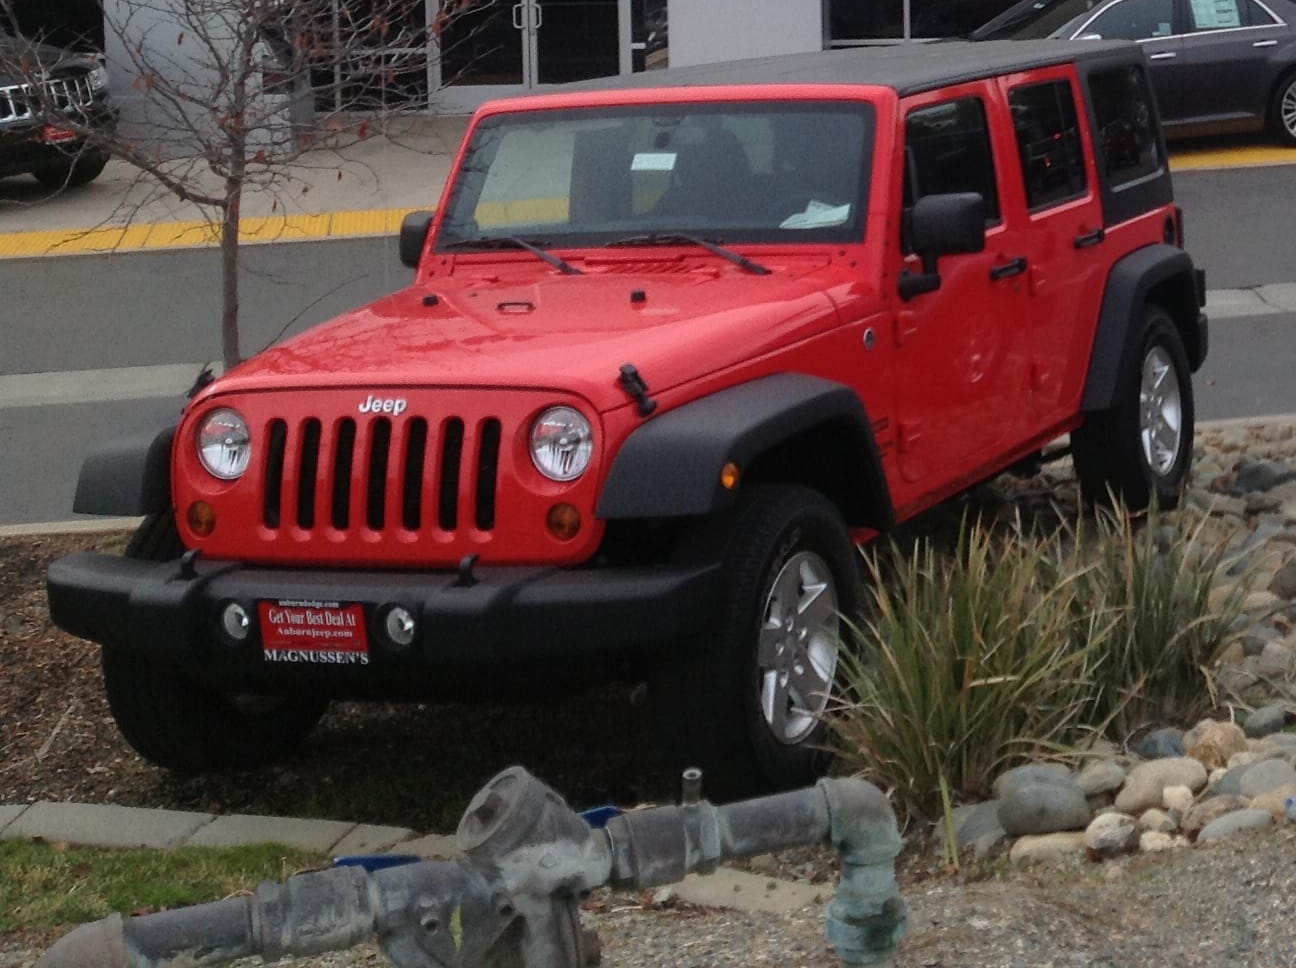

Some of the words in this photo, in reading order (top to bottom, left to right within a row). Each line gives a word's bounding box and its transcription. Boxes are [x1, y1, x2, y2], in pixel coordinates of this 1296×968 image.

[358, 395, 407, 416] Jeep
[268, 609, 284, 623] Get
[284, 610, 305, 625] Your
[305, 611, 324, 625] Best
[325, 612, 344, 626] Deal
[346, 613, 356, 626] At
[263, 649, 369, 665] MAGNUSSEN'S
